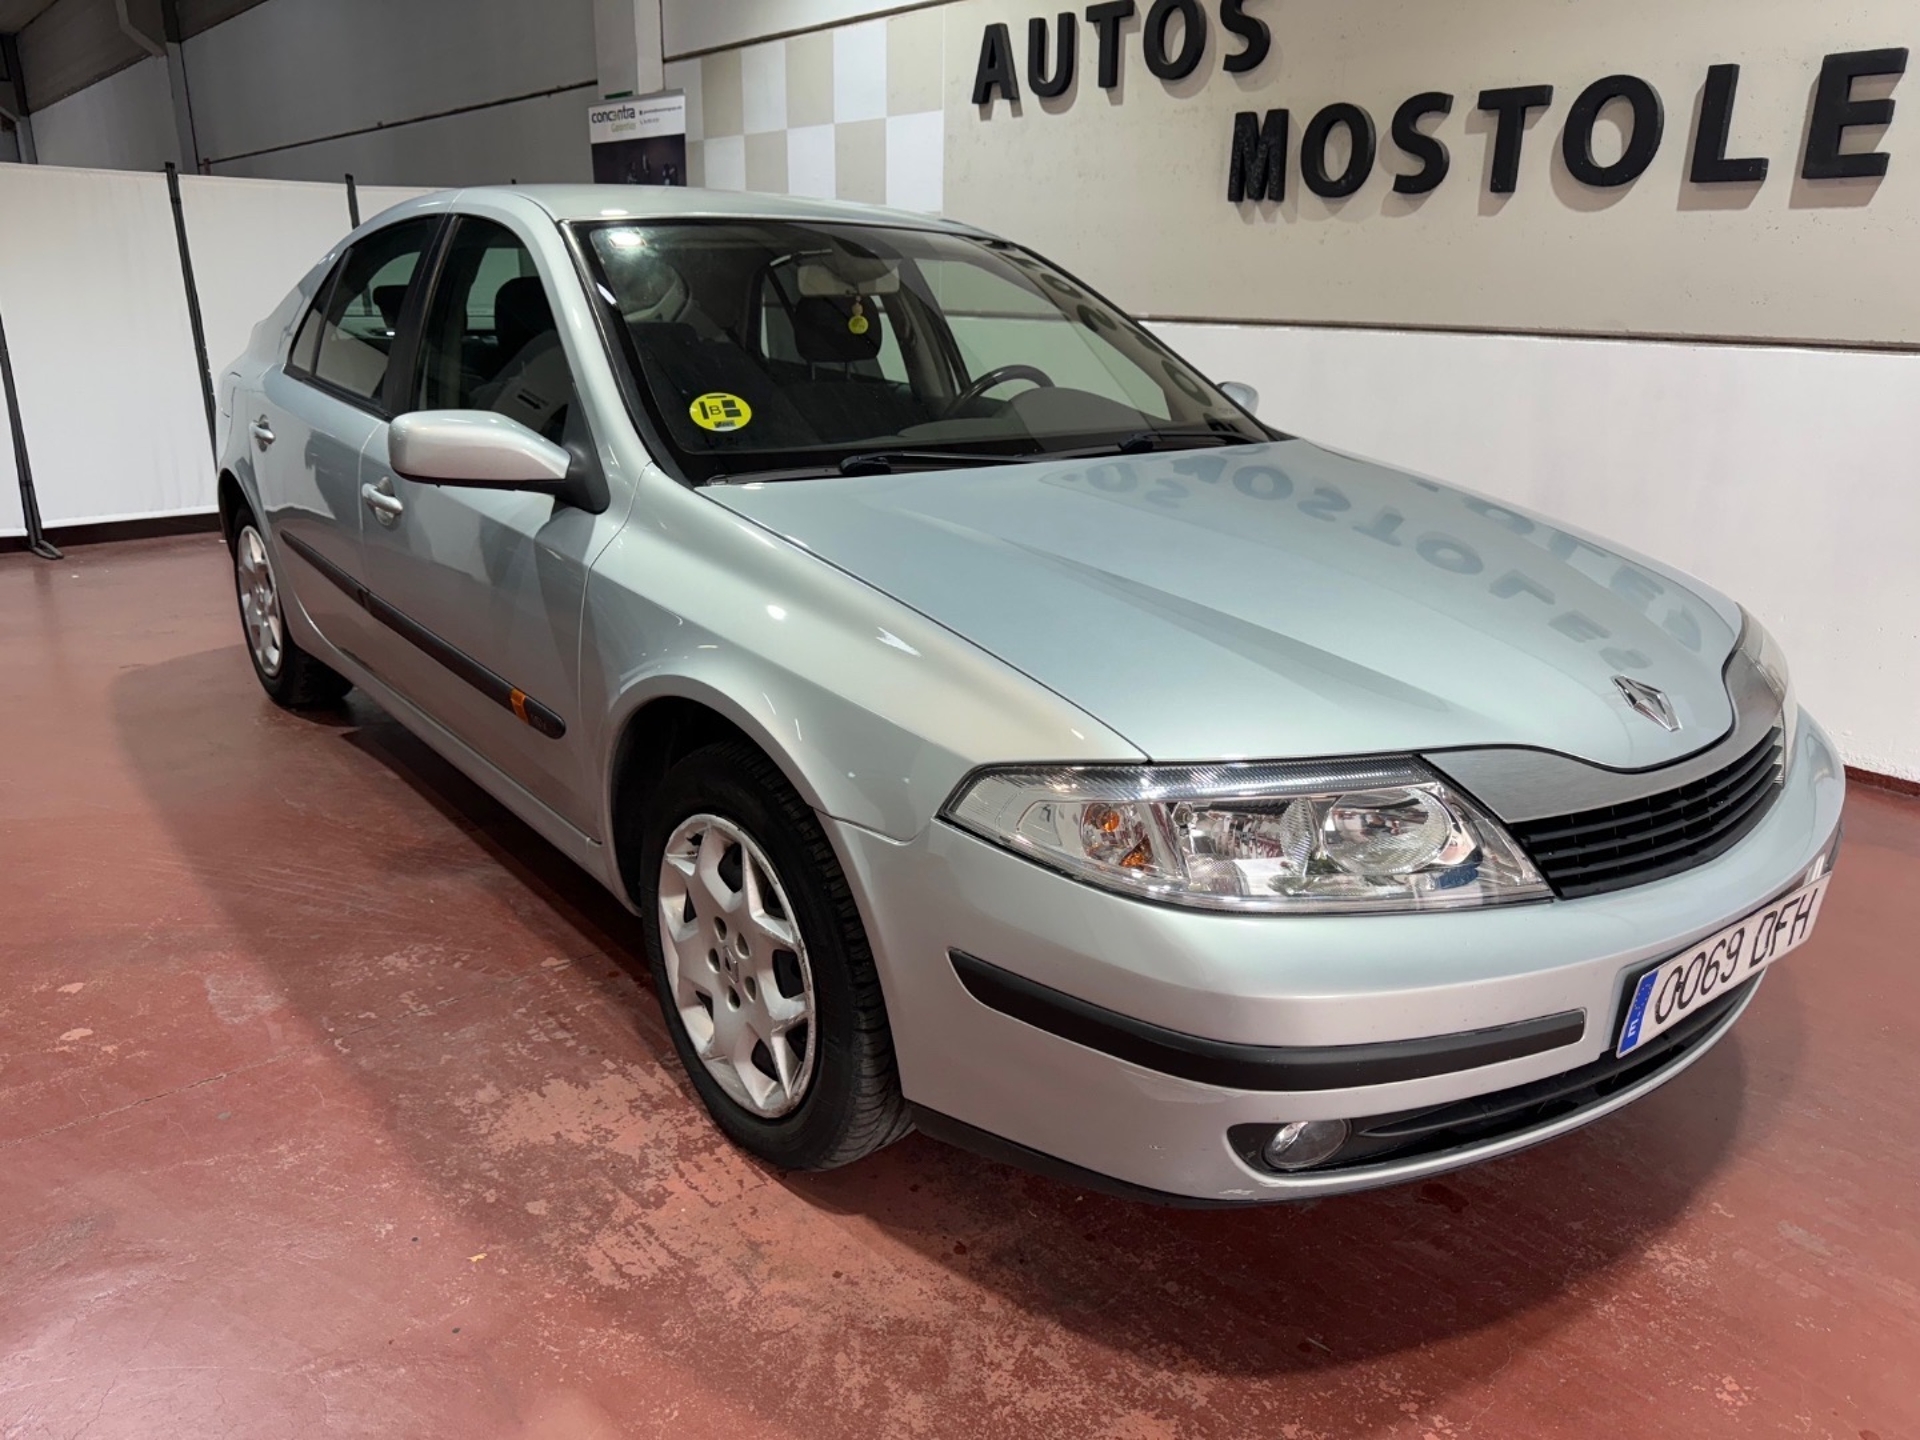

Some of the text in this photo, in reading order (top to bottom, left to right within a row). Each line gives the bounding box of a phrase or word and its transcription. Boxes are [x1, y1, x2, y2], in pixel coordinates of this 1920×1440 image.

[972, 0, 1271, 104] AUTOS
[1228, 48, 1909, 202] MOSTOLE
[709, 404, 722, 416] B
[1655, 887, 1819, 1025] 0069 DFH
